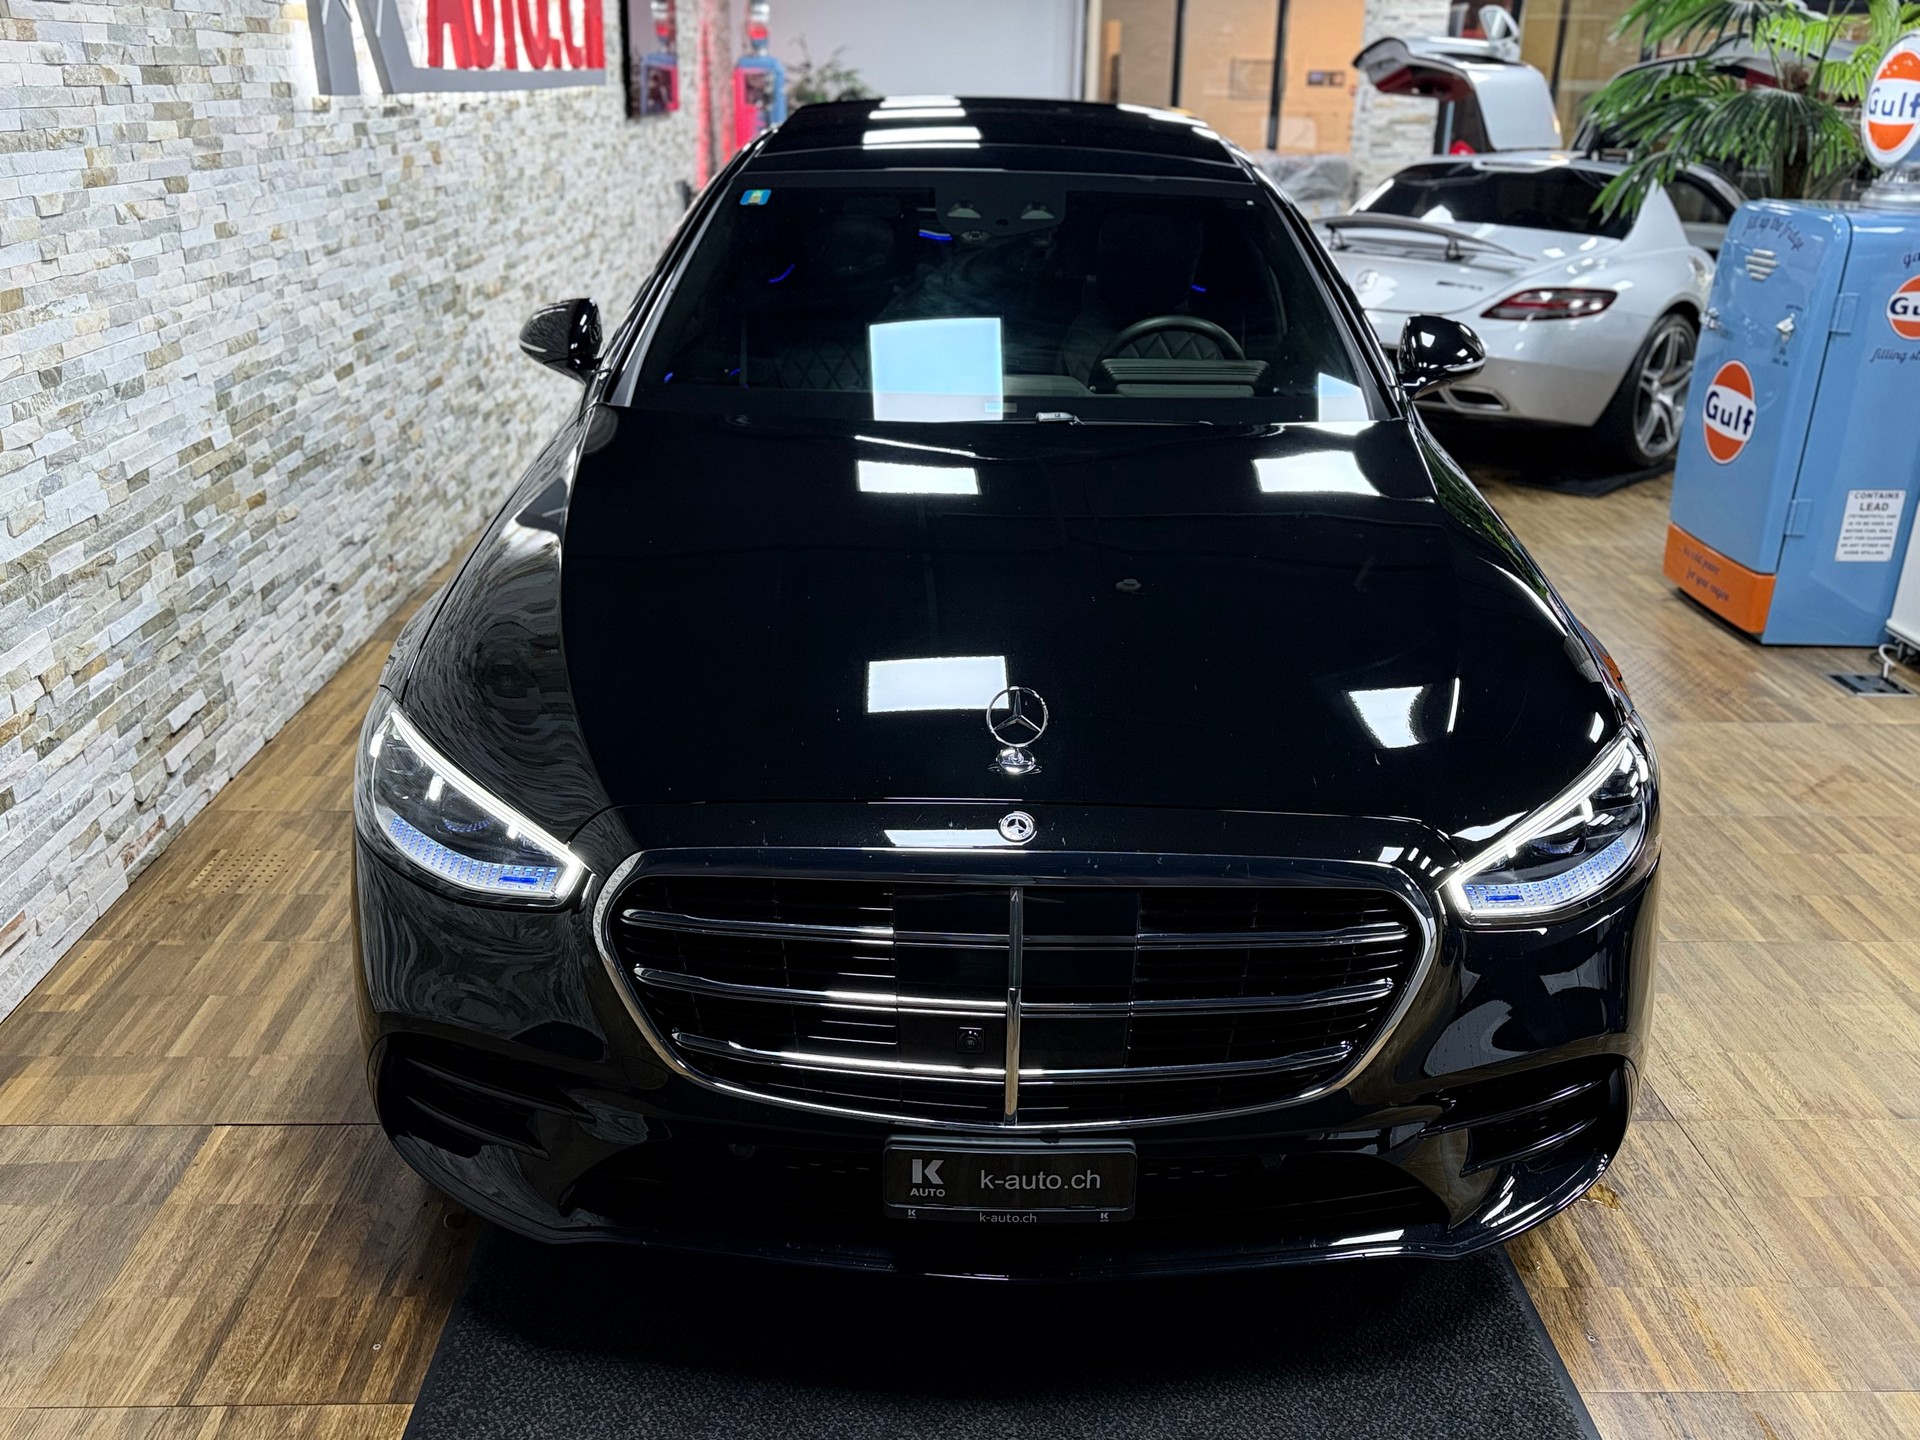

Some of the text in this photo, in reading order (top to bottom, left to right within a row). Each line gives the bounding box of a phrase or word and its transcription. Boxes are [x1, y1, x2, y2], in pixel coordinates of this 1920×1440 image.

[1869, 87, 1920, 118] Gulf
[1705, 390, 1754, 436] Gulf
[1854, 492, 1900, 500] CONTAINS
[1859, 502, 1890, 512] LEAD
[912, 1159, 945, 1185] K
[980, 1169, 1101, 1190] k-auto.ch
[910, 1188, 946, 1197] AUTO
[979, 1212, 1037, 1223] k-auto.ch
